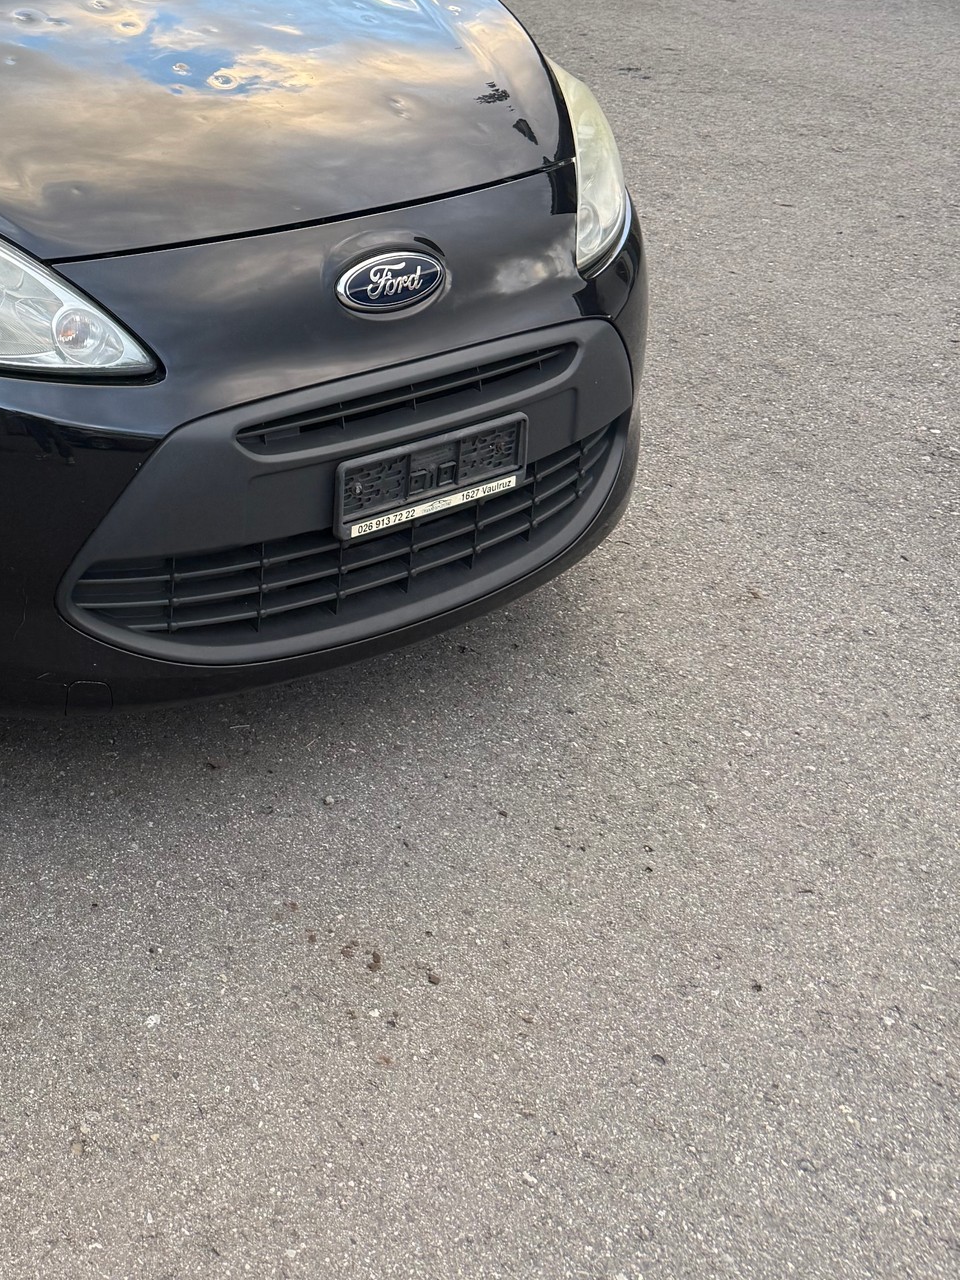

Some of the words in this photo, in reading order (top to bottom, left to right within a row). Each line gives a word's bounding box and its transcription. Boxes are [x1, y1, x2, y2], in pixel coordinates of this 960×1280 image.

[366, 261, 424, 300] Ford
[461, 488, 480, 501] 1627
[481, 480, 512, 495] Vaulruz
[357, 522, 374, 534] 026
[375, 516, 391, 529] 913
[393, 512, 404, 523] 72
[405, 508, 416, 520] 22
